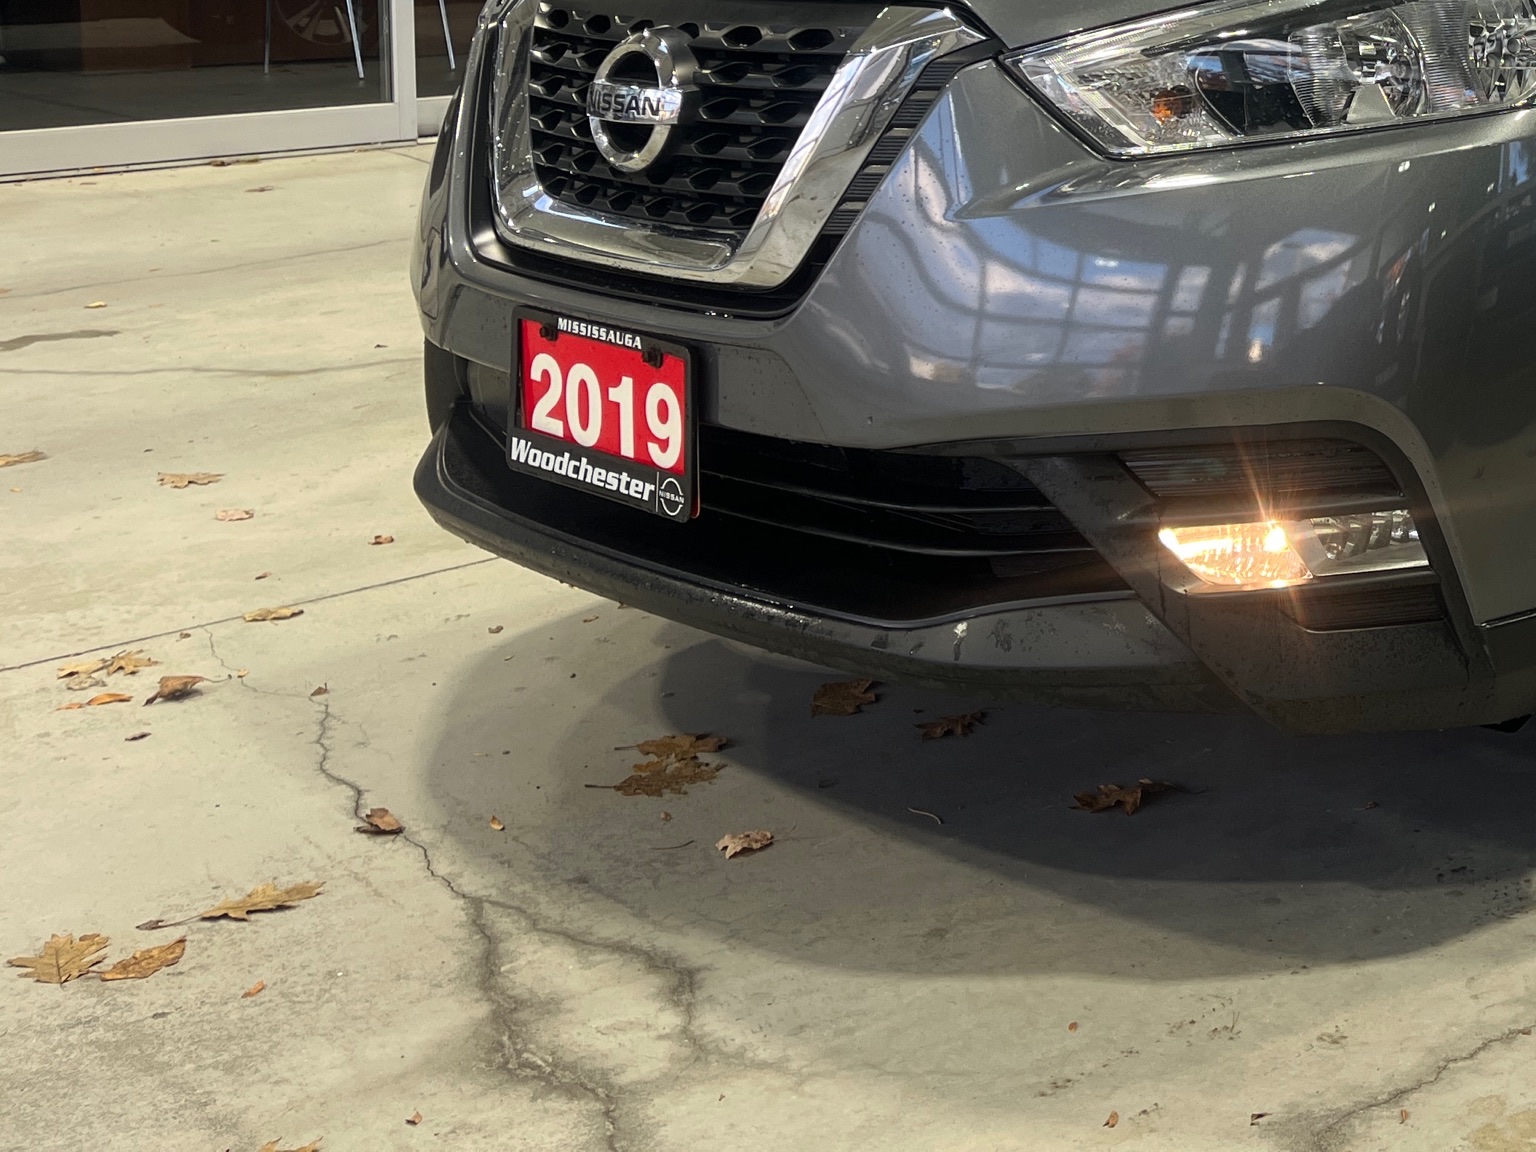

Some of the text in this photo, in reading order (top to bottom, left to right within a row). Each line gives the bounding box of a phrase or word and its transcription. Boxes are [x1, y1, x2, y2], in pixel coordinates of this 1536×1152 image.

[557, 317, 642, 349] MISSISSAUGA
[530, 352, 682, 469] 2019
[510, 436, 656, 502] Woodchester
[658, 489, 685, 505] NISSAN
